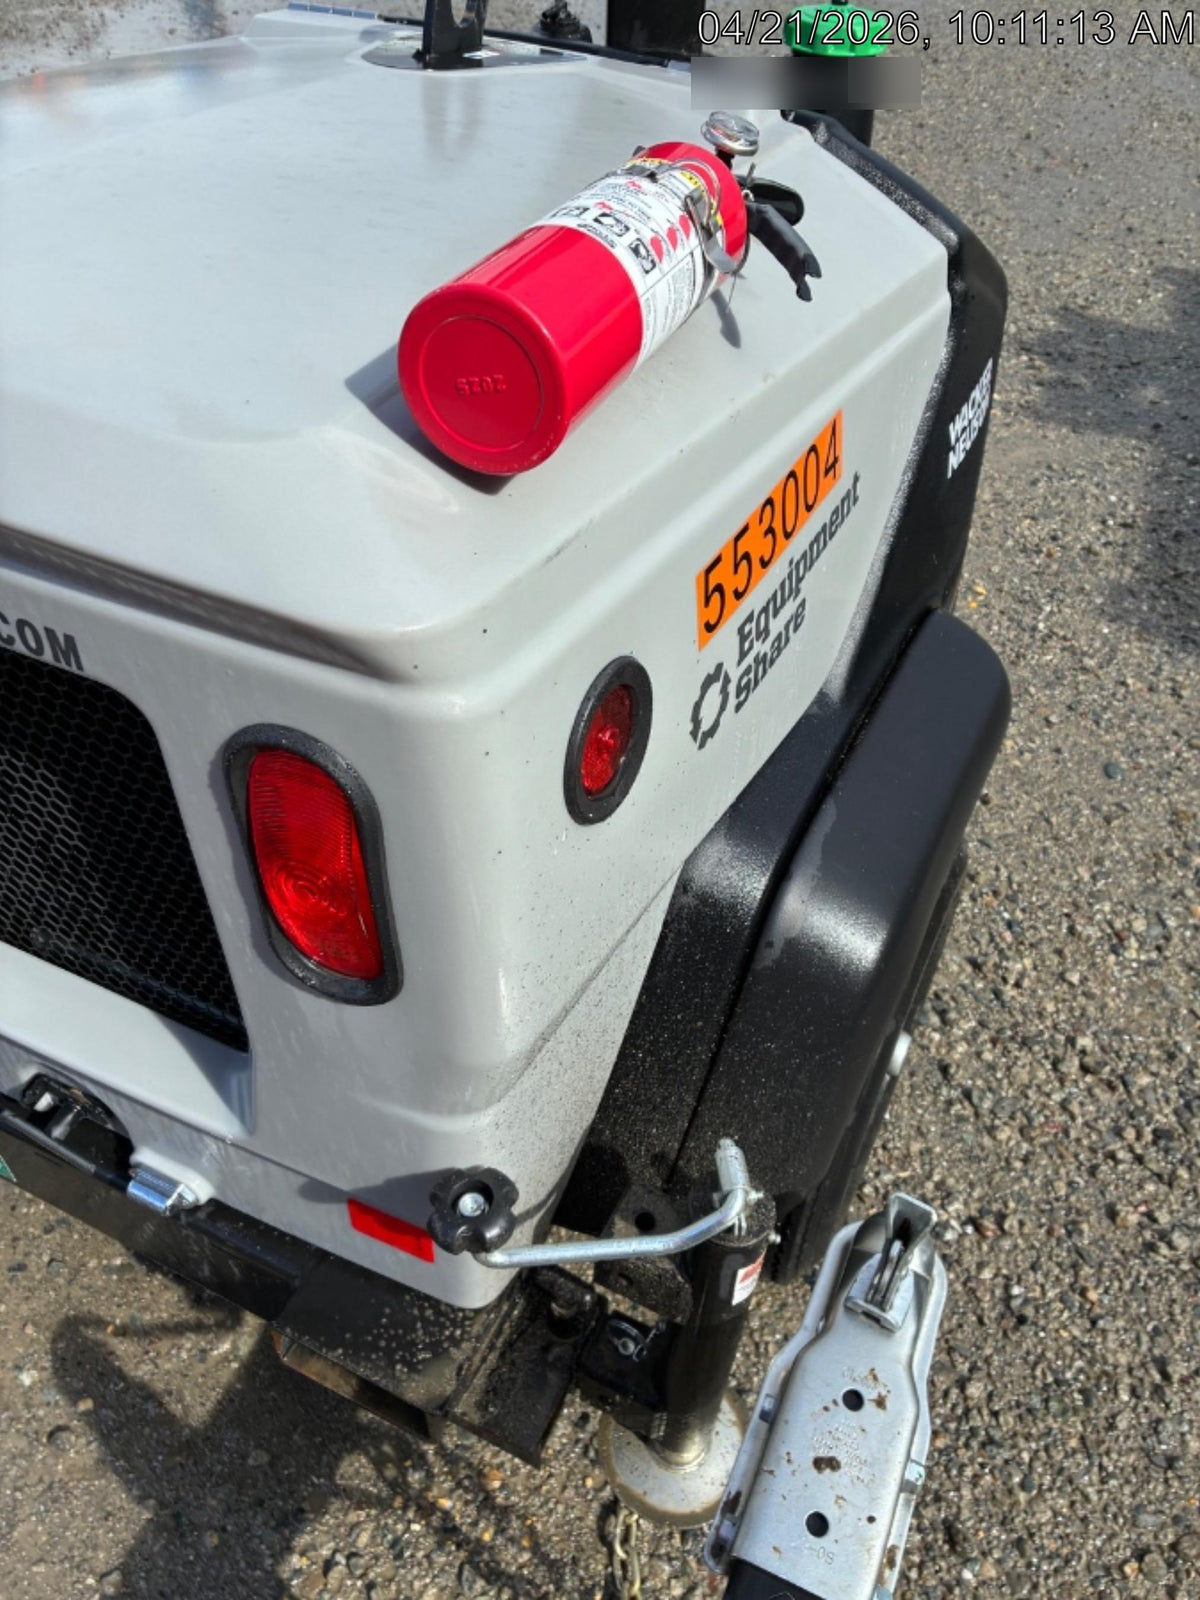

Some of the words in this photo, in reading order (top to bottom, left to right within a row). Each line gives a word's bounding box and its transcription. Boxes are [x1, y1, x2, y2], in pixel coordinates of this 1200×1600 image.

[703, 417, 840, 634] 553004
[737, 470, 861, 668] Equipment
[734, 597, 807, 714] Share
